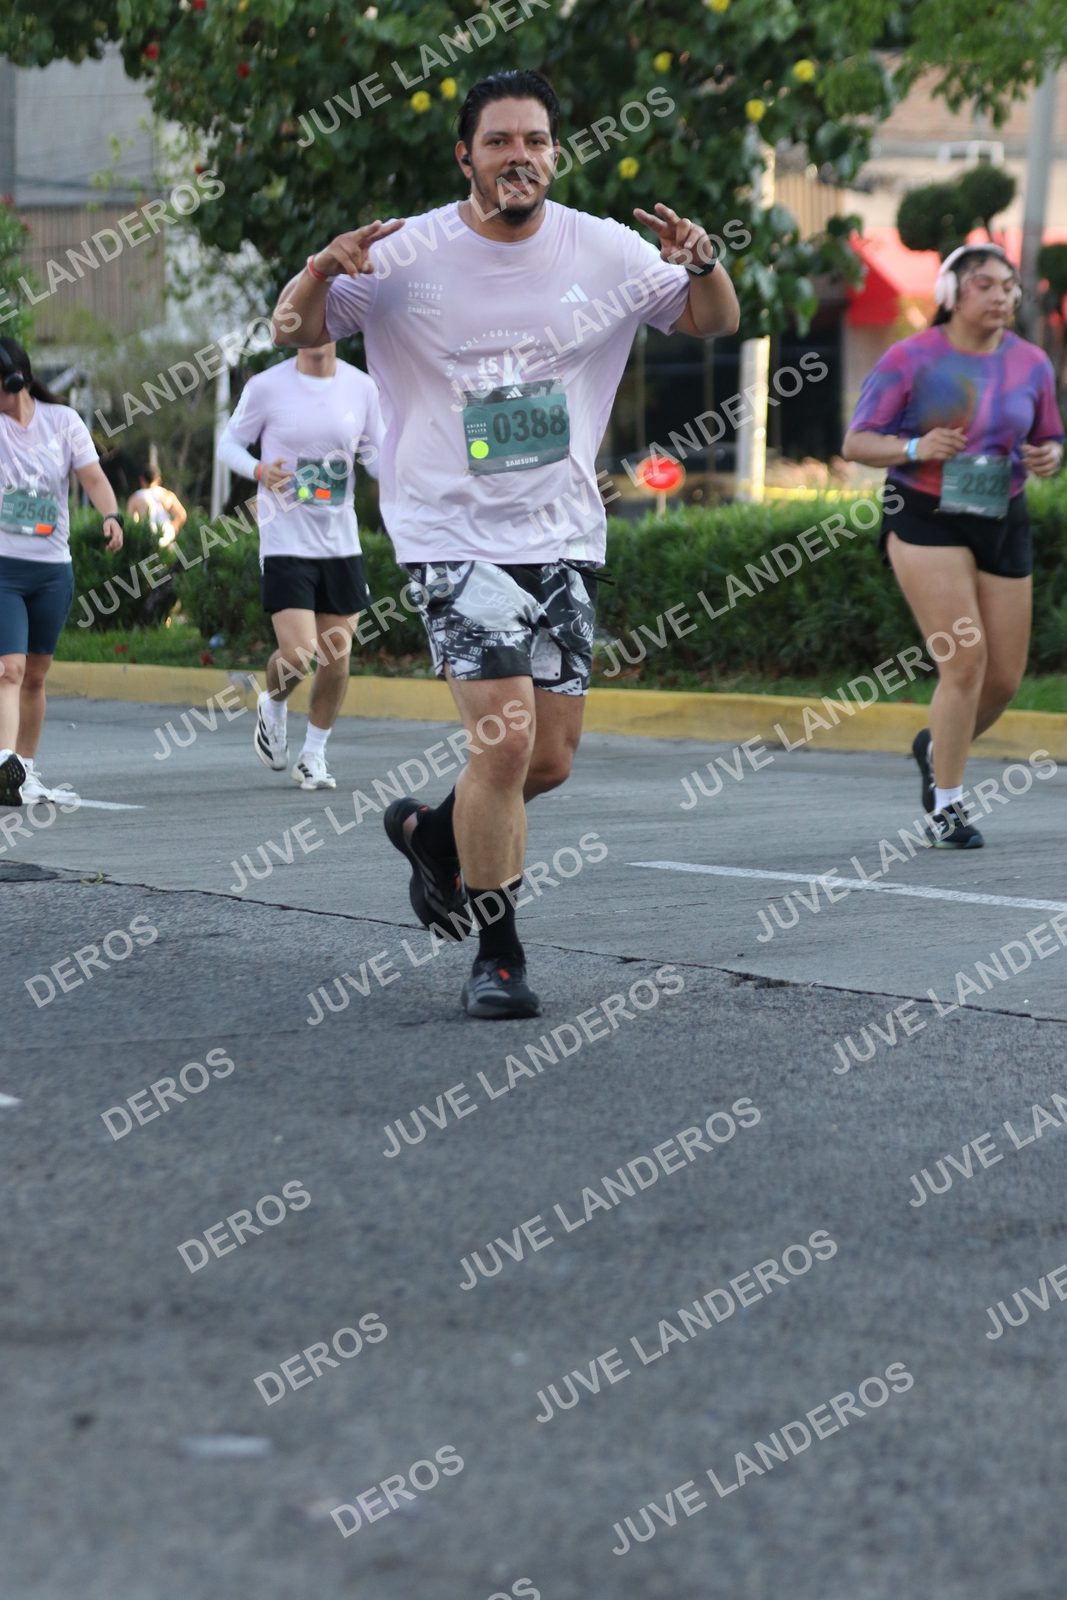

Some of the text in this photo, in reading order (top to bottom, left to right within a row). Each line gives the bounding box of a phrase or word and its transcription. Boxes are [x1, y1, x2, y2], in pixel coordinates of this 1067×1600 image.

[493, 404, 567, 444] 0388
[505, 456, 539, 467] SAMSUNG
[16, 501, 58, 522] 2546
